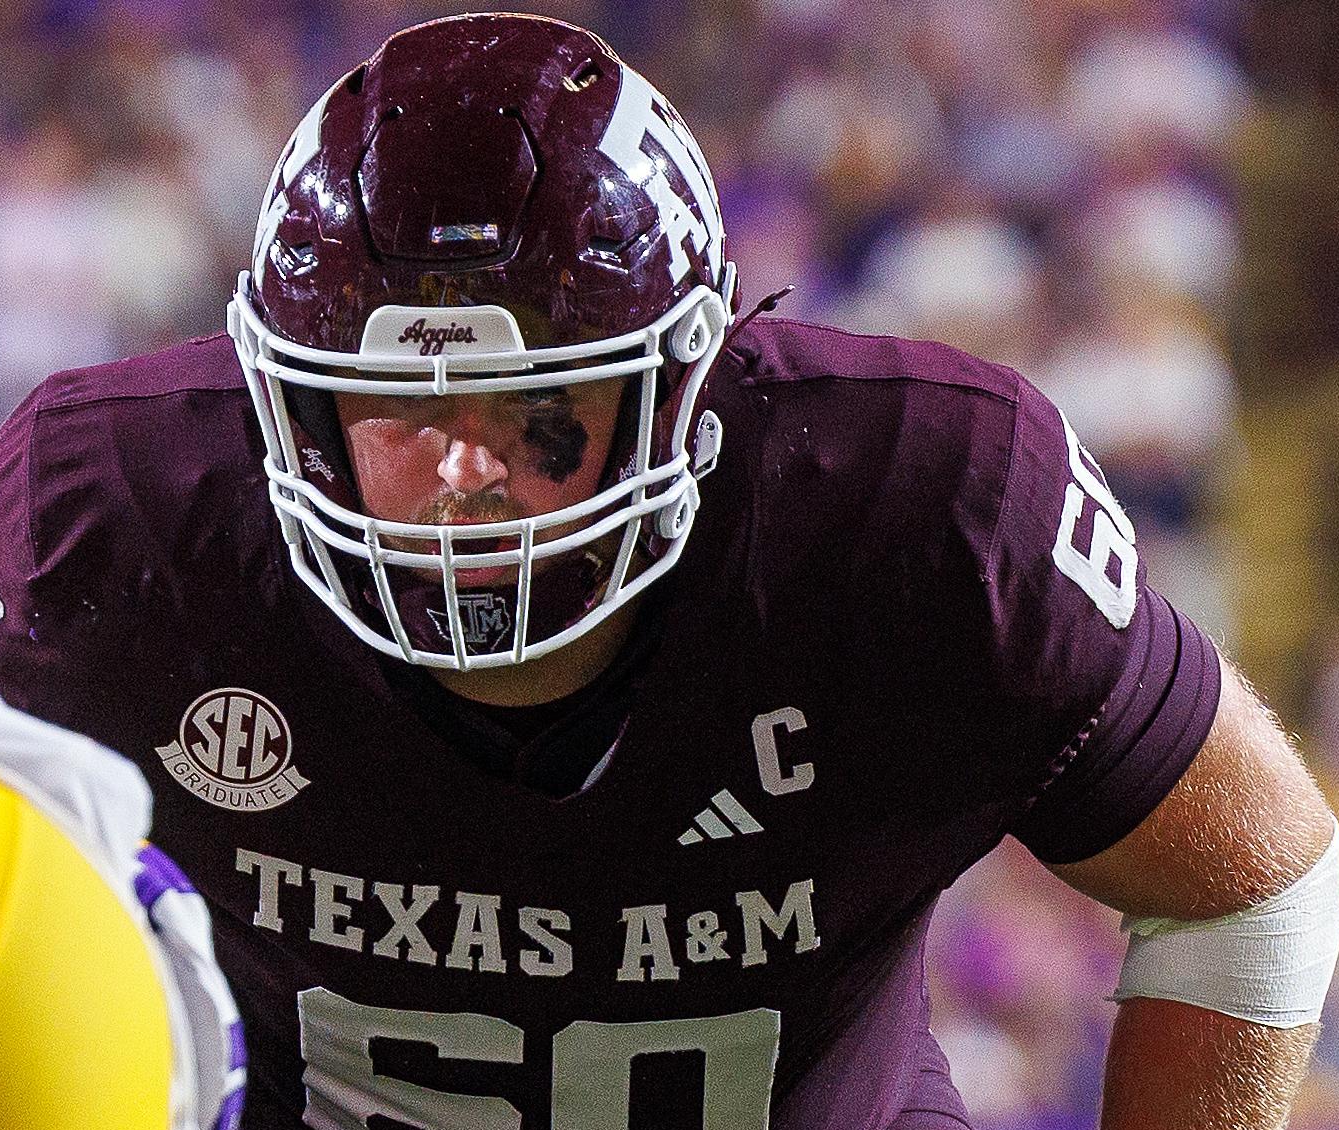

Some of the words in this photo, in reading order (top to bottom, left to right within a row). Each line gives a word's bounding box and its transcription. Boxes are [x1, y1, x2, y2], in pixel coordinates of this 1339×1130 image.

[398, 318, 478, 356] Aggies
[301, 447, 335, 483] Aggies
[190, 695, 282, 780] SEC
[750, 706, 816, 797] C
[173, 761, 287, 808] GRADUATE
[235, 847, 574, 978] TEXAS
[615, 878, 822, 982] A&M
